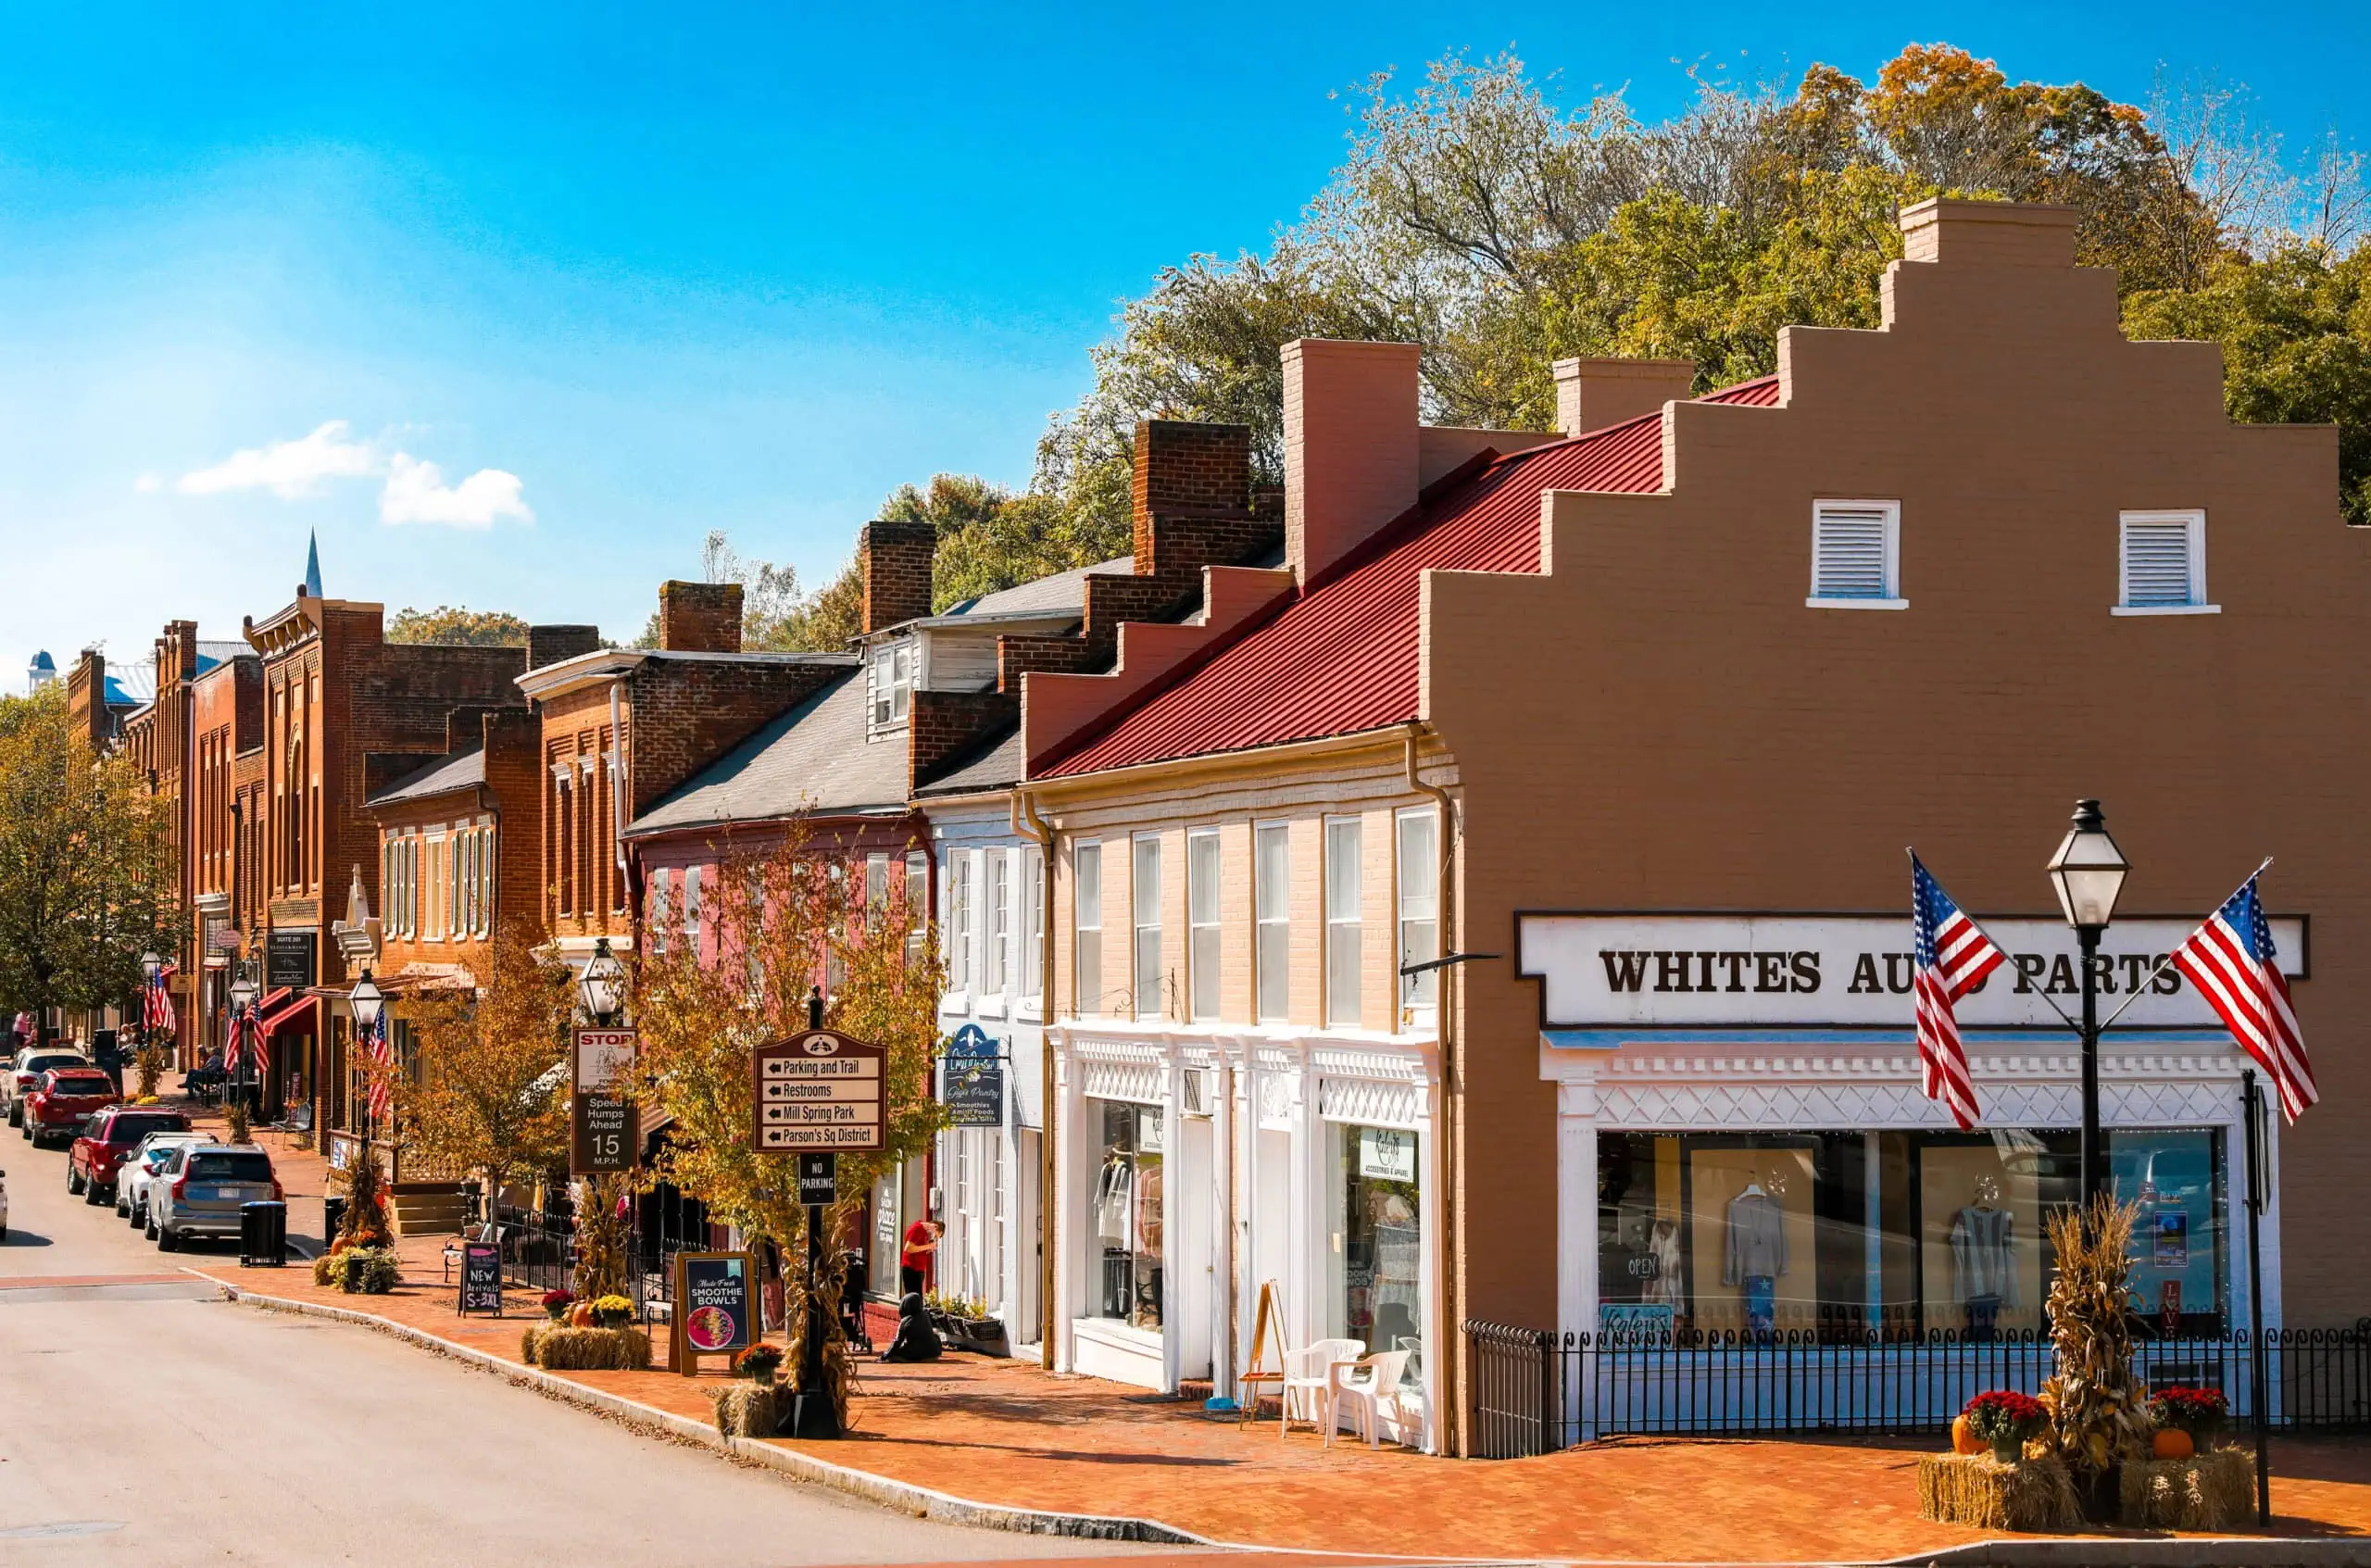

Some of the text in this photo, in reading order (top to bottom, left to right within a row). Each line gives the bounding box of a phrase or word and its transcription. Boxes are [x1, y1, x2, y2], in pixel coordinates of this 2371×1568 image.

[1598, 950, 1821, 994] WHITE'S
[2012, 953, 2182, 994] PARTS
[581, 1035, 632, 1046] STOP
[784, 1060, 859, 1076] Parking and Trail
[784, 1084, 832, 1097] Restrooms
[971, 1086, 999, 1099] Pantry
[589, 1098, 622, 1109] Speed
[587, 1110, 624, 1120] Humps
[784, 1105, 855, 1122] Mill Spring Park
[589, 1120, 622, 1129] Ahead
[784, 1128, 871, 1144] Parson's Sq District
[592, 1135, 620, 1155] 15
[811, 1162, 822, 1174] NO
[801, 1177, 834, 1189] PARKING
[1628, 1255, 1658, 1275] OPEN
[470, 1269, 495, 1282] NEW
[466, 1283, 499, 1293] Arrivals
[697, 1278, 735, 1287] Made Fresh
[691, 1287, 743, 1297] SMOOTHIE
[467, 1292, 499, 1308] S-3XL
[697, 1296, 737, 1305] BOWLS
